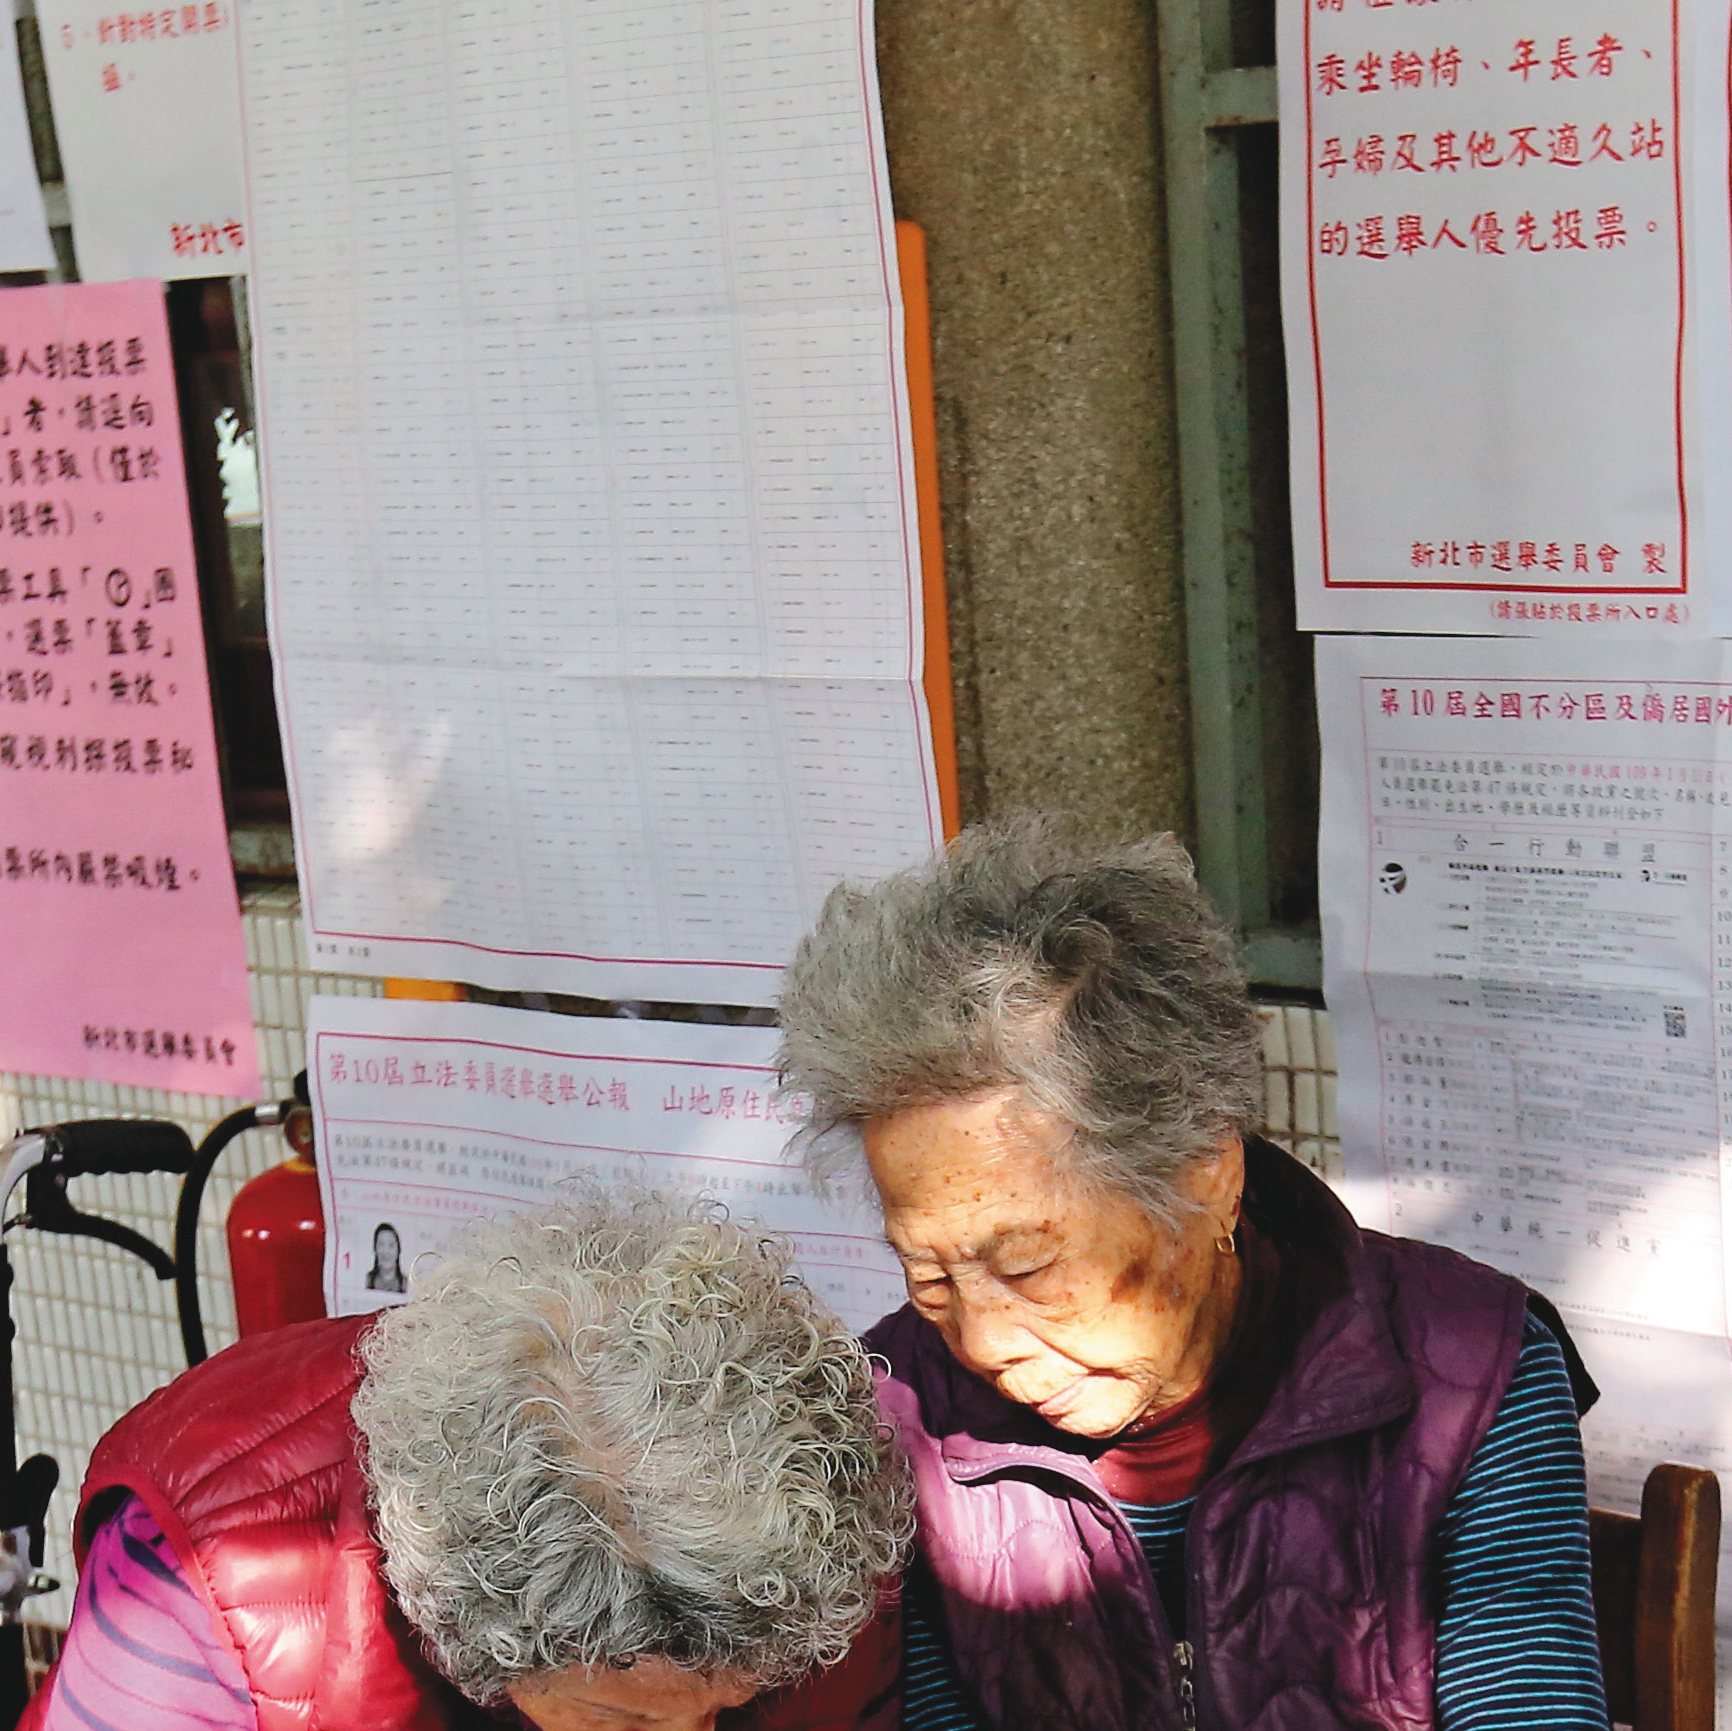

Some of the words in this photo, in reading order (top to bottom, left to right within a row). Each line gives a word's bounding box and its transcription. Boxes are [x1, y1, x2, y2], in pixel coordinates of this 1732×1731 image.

[1316, 33, 1653, 96] 乘坐輪椅、年長者、
[1319, 119, 1664, 179] 孕婦及其他不適久站
[1320, 206, 1657, 260] 的選舉人優先投票。
[1410, 540, 1620, 576] 新北市選舉委員會
